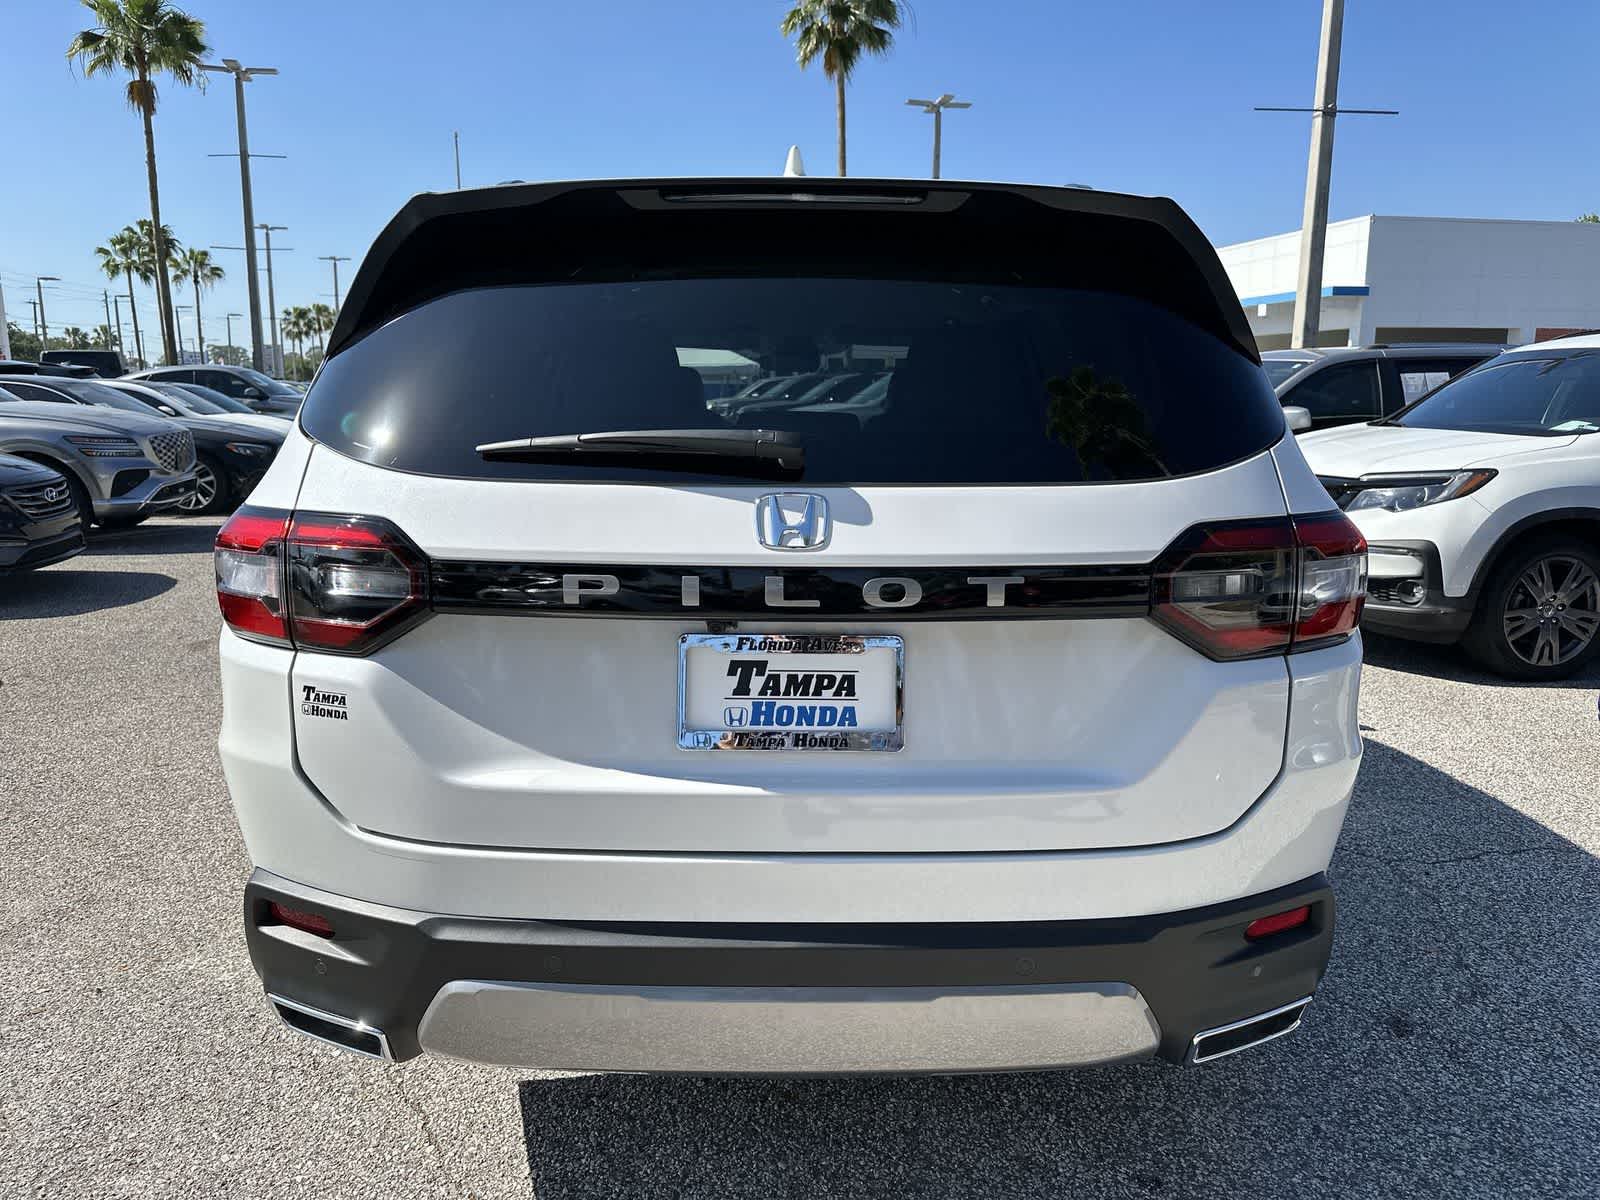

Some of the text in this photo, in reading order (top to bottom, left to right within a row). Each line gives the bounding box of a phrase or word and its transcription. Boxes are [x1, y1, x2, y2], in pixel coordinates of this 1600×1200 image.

[562, 574, 1025, 608] PILOT
[735, 636, 801, 651] FLORIDA
[726, 659, 857, 697] TAMPA
[302, 685, 347, 706] TAMPA
[311, 705, 348, 720] HONDA
[749, 701, 858, 727] HONDA
[734, 732, 849, 748] TAMPA HONDA
